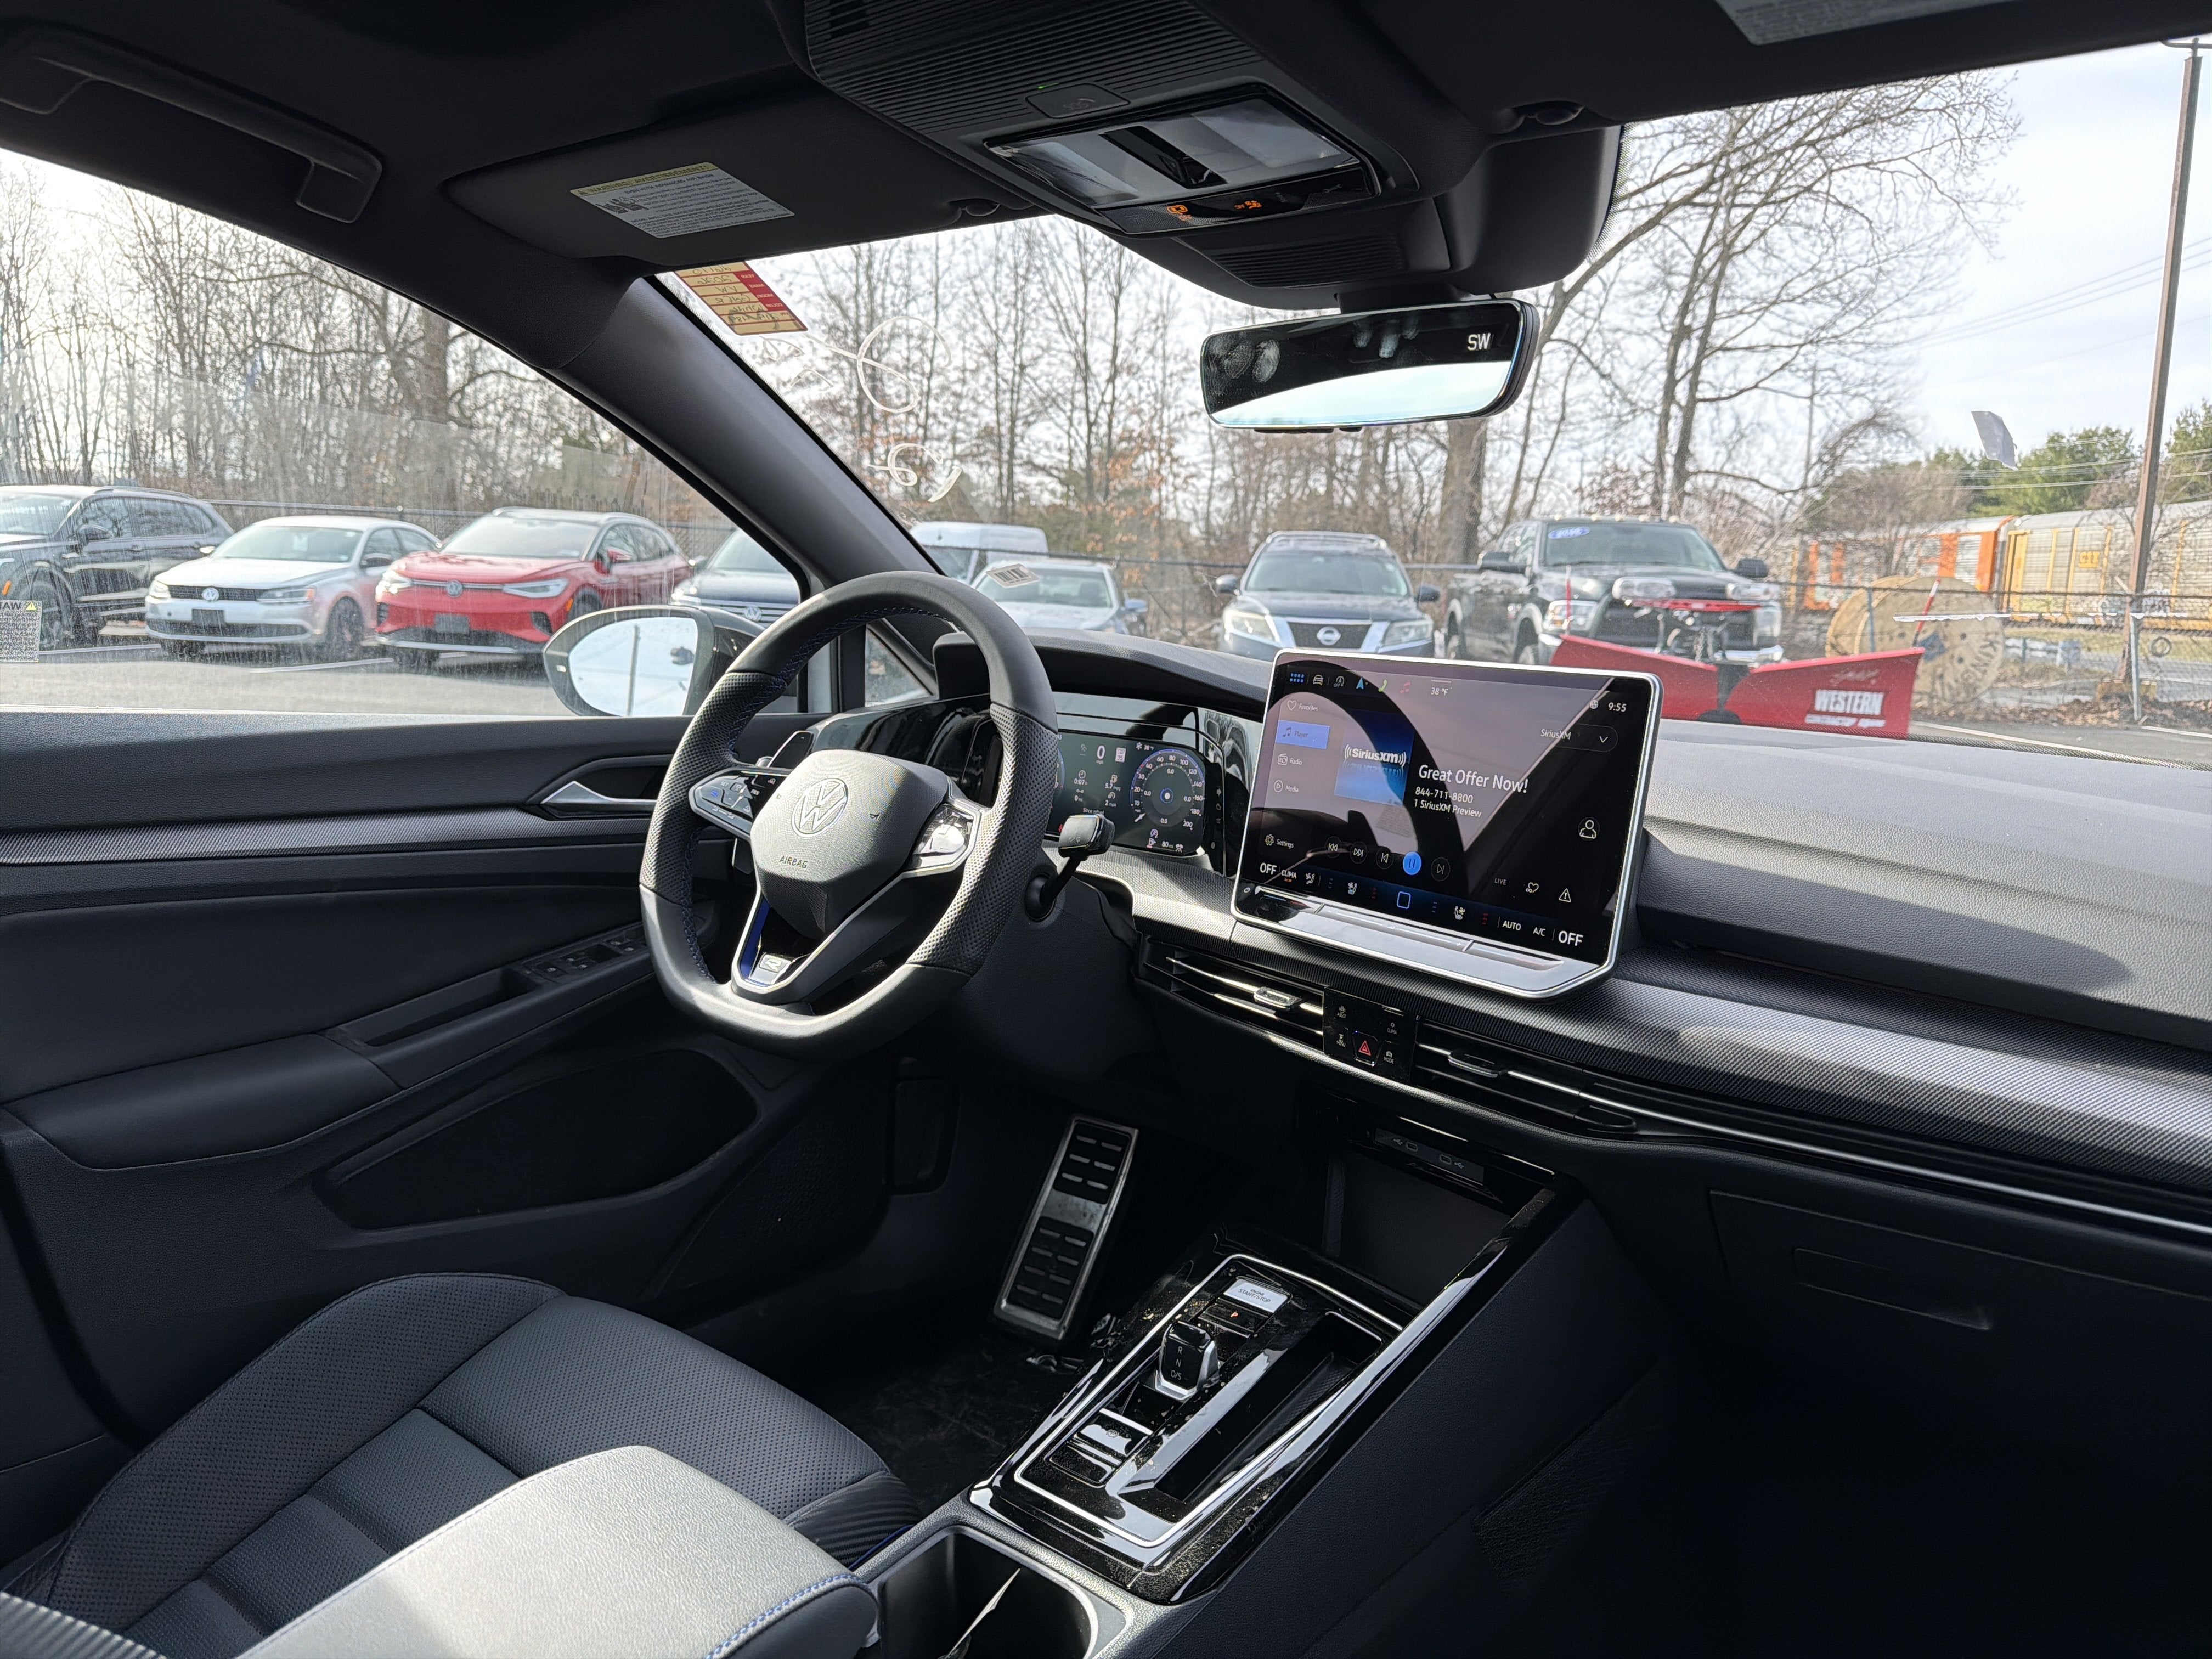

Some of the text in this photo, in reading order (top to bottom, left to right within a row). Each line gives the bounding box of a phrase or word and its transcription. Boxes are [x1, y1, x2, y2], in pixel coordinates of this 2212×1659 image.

[1467, 332, 1491, 351] SW
[1430, 687, 1440, 695] 38
[1299, 703, 1319, 712] Favorites
[1608, 702, 1627, 712] 9:55
[1814, 689, 1884, 715] WESTERN
[1294, 730, 1308, 738] Player
[1541, 729, 1572, 740] SiriusXM
[1097, 745, 1105, 759] 0
[1290, 758, 1303, 766] Radio
[1418, 764, 1529, 794] Great Offer Now!
[1285, 785, 1299, 793] Media
[1415, 786, 1474, 804] 844-711-8800
[1414, 799, 1482, 818] 1 SiriusXM Preview
[1277, 839, 1294, 849] Settings
[779, 855, 808, 869] AIRBAG
[1260, 862, 1278, 875] OFF
[1281, 870, 1297, 879] CLIMA
[1502, 920, 1521, 931] AUTO
[1533, 927, 1546, 937] A/C
[1558, 930, 1584, 946] OFF
[1384, 1056, 1394, 1064] MODE
[1238, 1288, 1271, 1303] START/STOP
[1177, 1346, 1183, 1355] R
[1176, 1358, 1181, 1368] N
[1170, 1369, 1182, 1380] D/S
